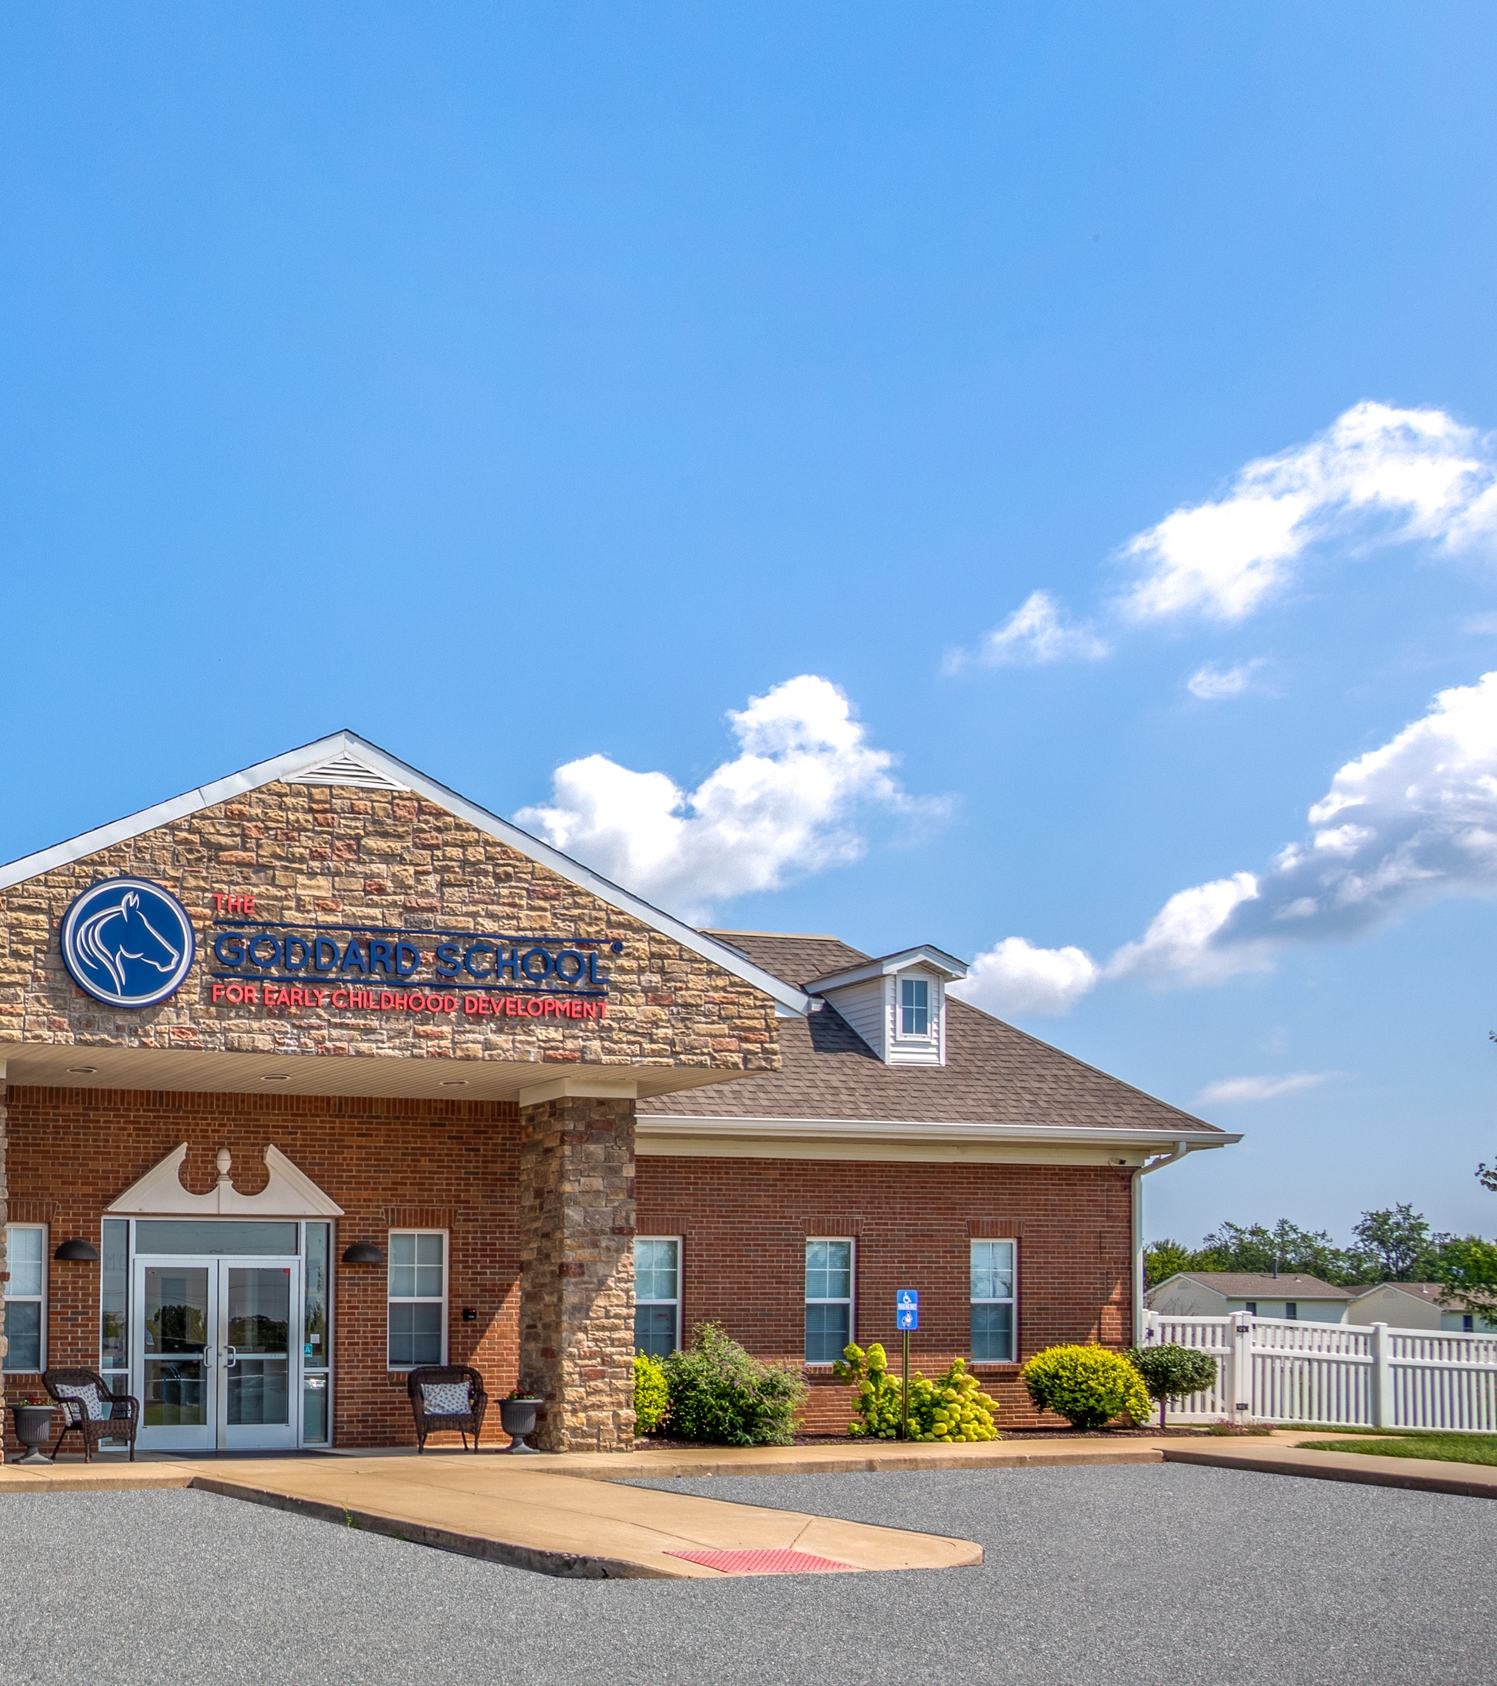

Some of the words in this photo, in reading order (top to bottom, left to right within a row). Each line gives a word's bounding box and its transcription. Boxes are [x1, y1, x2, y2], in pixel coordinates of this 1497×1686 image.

[212, 893, 256, 915] THE
[215, 932, 420, 976] GODDARD
[212, 984, 258, 1005] FOR
[264, 986, 328, 1008] EARLY
[331, 989, 458, 1014] CHILDHOOD
[464, 996, 609, 1019] DEVELOPMENT
